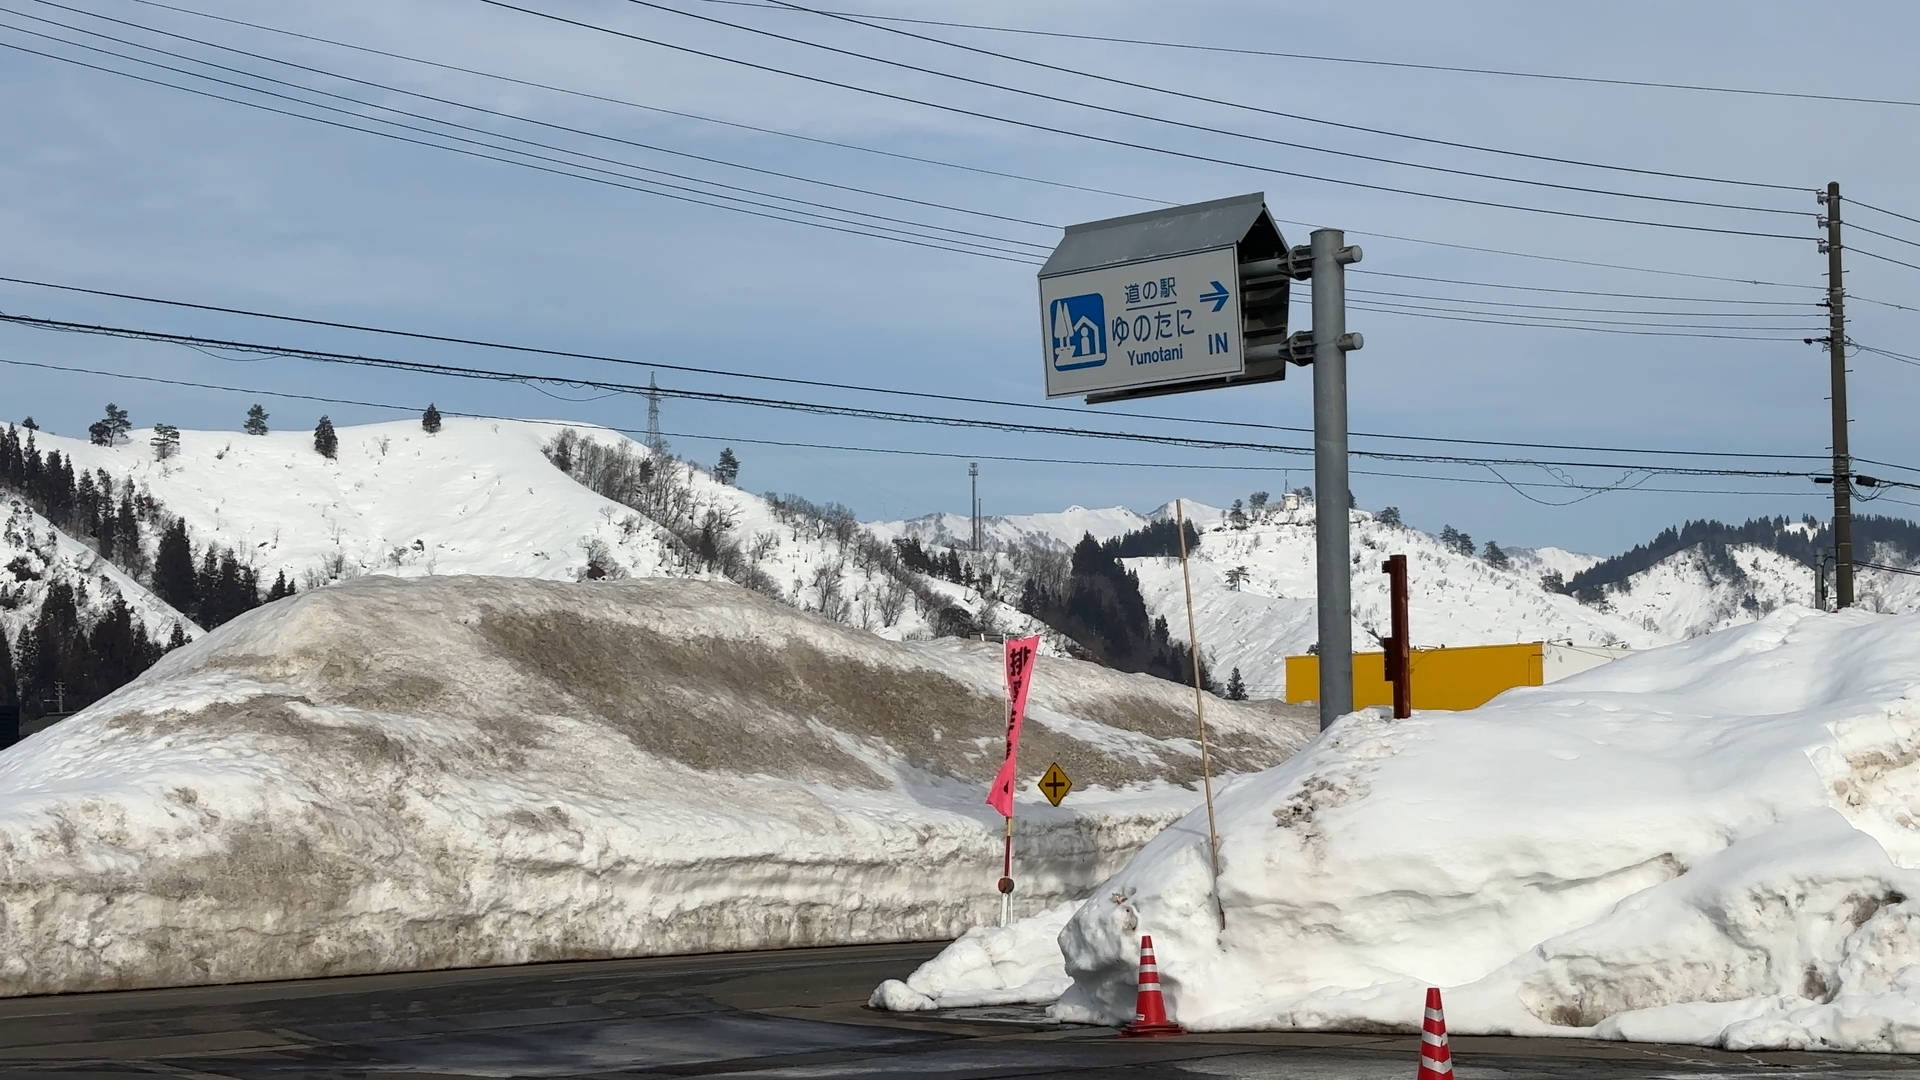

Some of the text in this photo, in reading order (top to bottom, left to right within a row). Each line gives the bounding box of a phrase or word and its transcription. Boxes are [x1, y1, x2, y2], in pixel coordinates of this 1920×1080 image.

[1124, 277, 1177, 304] 道の駅
[1112, 309, 1195, 346] ゆのたに
[1127, 343, 1183, 366] Yunotani
[1208, 332, 1228, 355] IN
